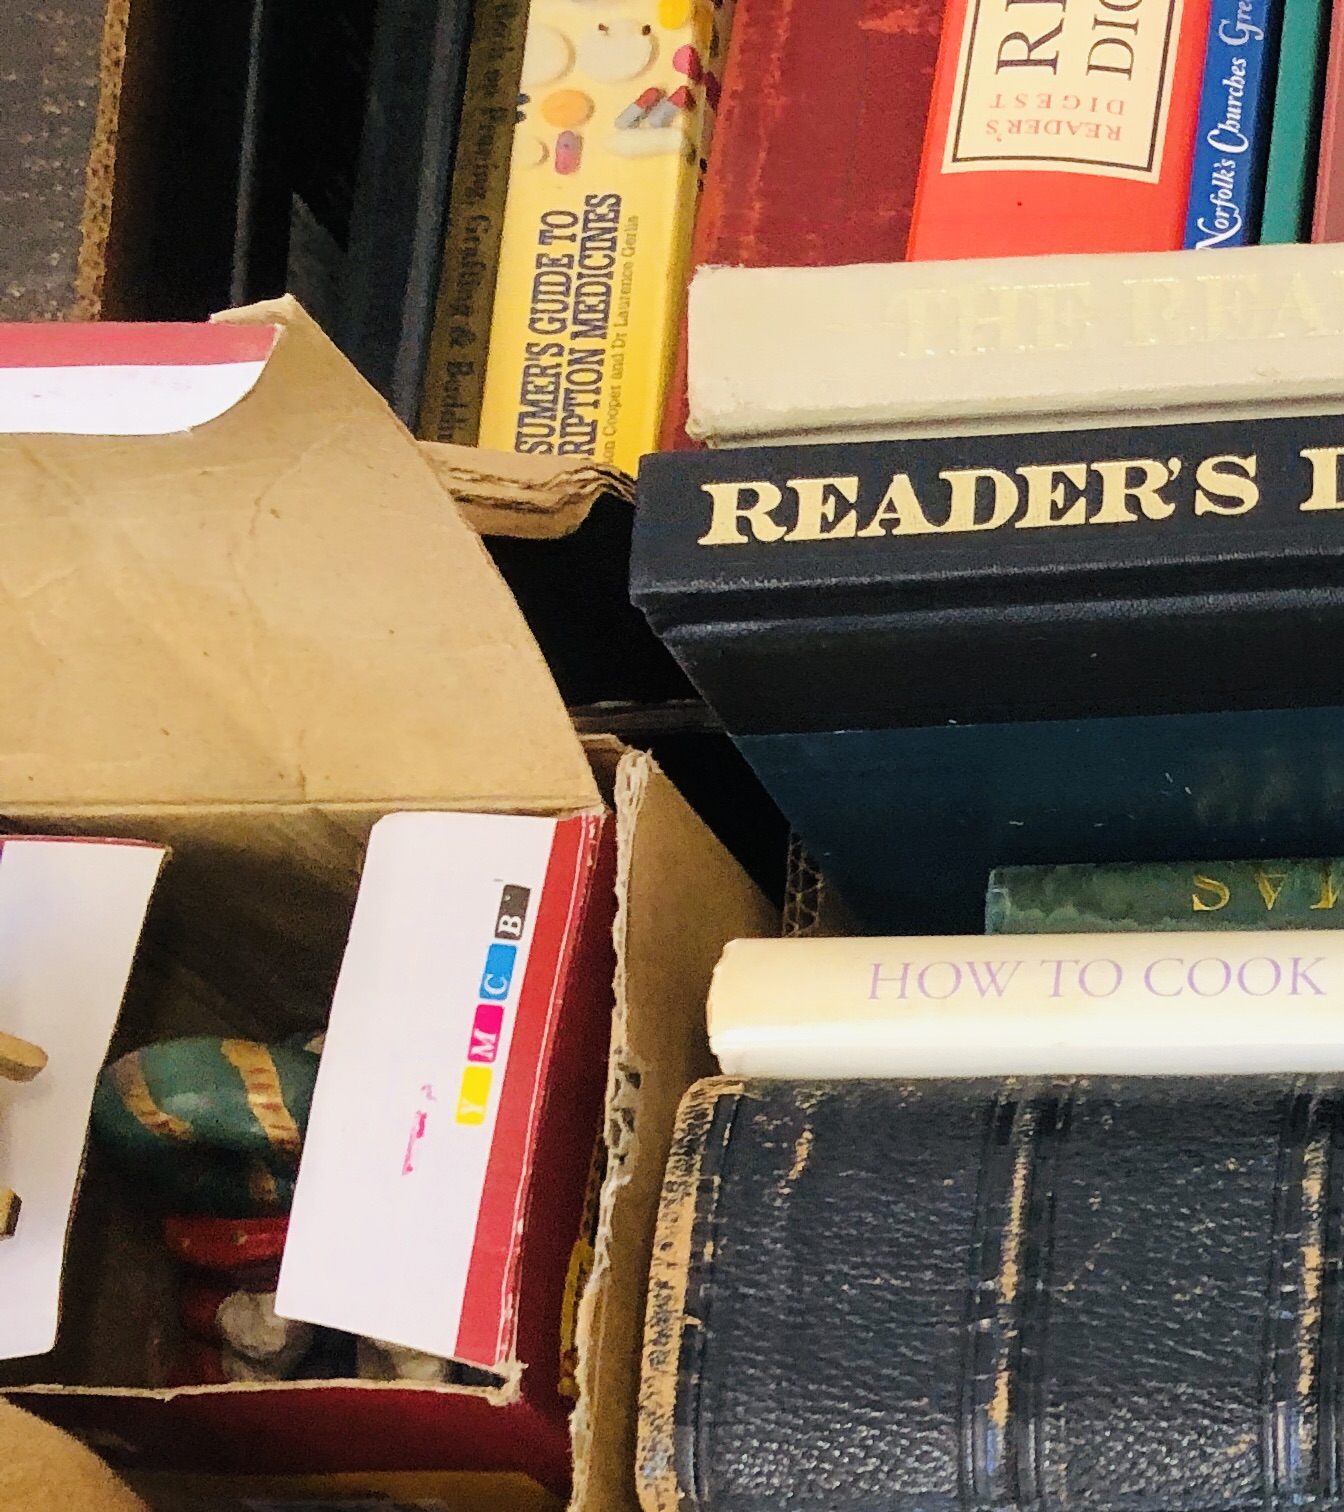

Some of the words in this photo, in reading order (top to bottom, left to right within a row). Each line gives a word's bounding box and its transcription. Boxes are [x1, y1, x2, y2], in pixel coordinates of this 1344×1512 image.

[1218, 0, 1264, 46] Gre
[990, 92, 1126, 116] DIGEST
[1206, 56, 1249, 153] Churches
[985, 117, 1122, 143] READER'S
[1195, 158, 1242, 251] Norfolk's
[538, 210, 579, 246] TO
[570, 193, 622, 341] MEDICINES
[527, 253, 575, 336] GUIDE
[613, 261, 634, 327] Laurence
[448, 325, 476, 348] &
[610, 332, 627, 349] Dr
[899, 280, 1092, 358] THE
[609, 353, 624, 380] and
[556, 347, 606, 459] RIPTION
[601, 385, 622, 437] Cooper
[698, 453, 1261, 547] READER'S
[483, 973, 510, 997] C
[867, 959, 1026, 1002] HOW
[1038, 956, 1124, 999] TO
[1144, 956, 1329, 999] COOK
[469, 1028, 498, 1061] M
